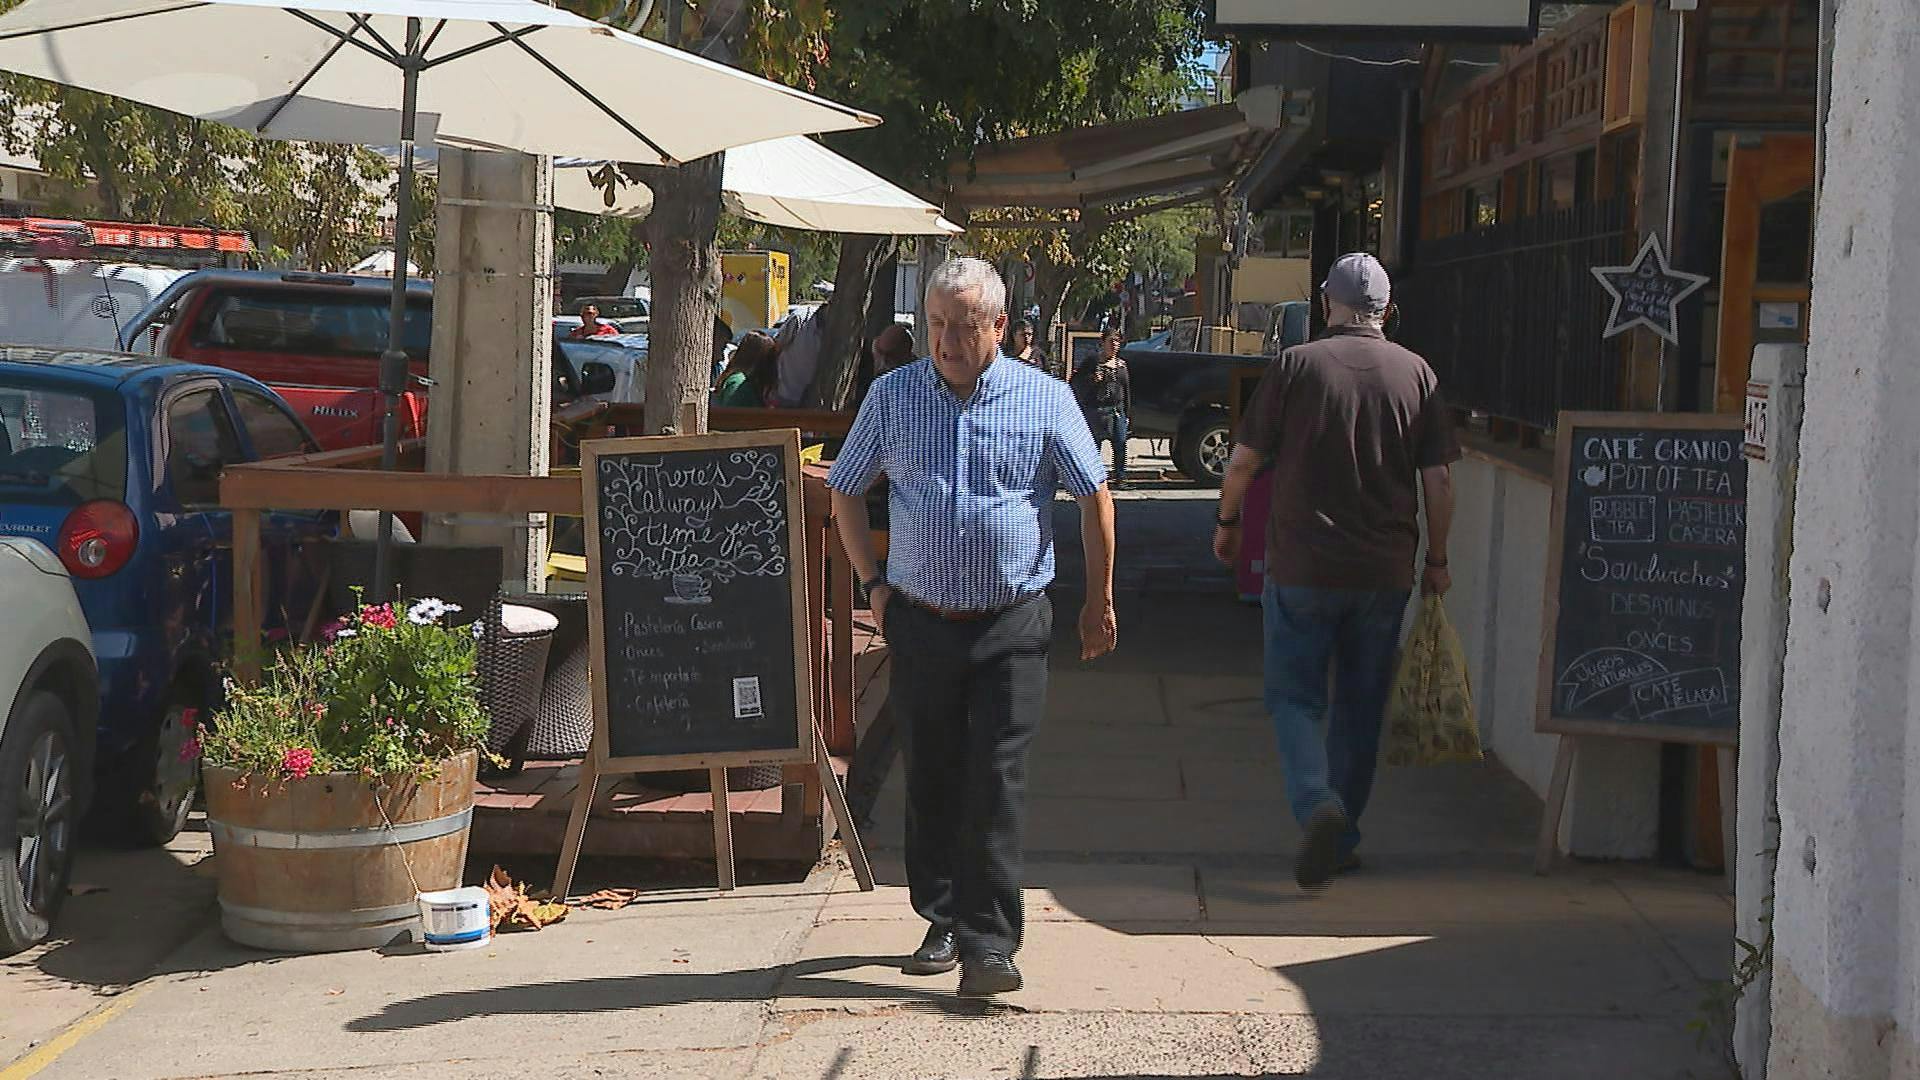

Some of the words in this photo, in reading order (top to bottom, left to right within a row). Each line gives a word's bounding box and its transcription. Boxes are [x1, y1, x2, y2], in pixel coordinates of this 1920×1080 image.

[313, 405, 358, 417] HILUX
[1584, 432, 1644, 460] CAFÉ
[1654, 438, 1732, 462] GRANO
[630, 457, 733, 488] There's
[1608, 463, 1652, 491] POT
[1655, 465, 1688, 492] OF
[1694, 468, 1732, 496] TEA
[1593, 500, 1648, 520] BUBBLE
[641, 516, 716, 547] time
[1608, 520, 1635, 535] TEA
[1669, 524, 1738, 545] CASERA
[662, 545, 702, 572] Tea
[1581, 546, 1729, 590] Sandwiches
[1627, 630, 1694, 653] ONCES
[1571, 654, 1624, 682] JUGOS
